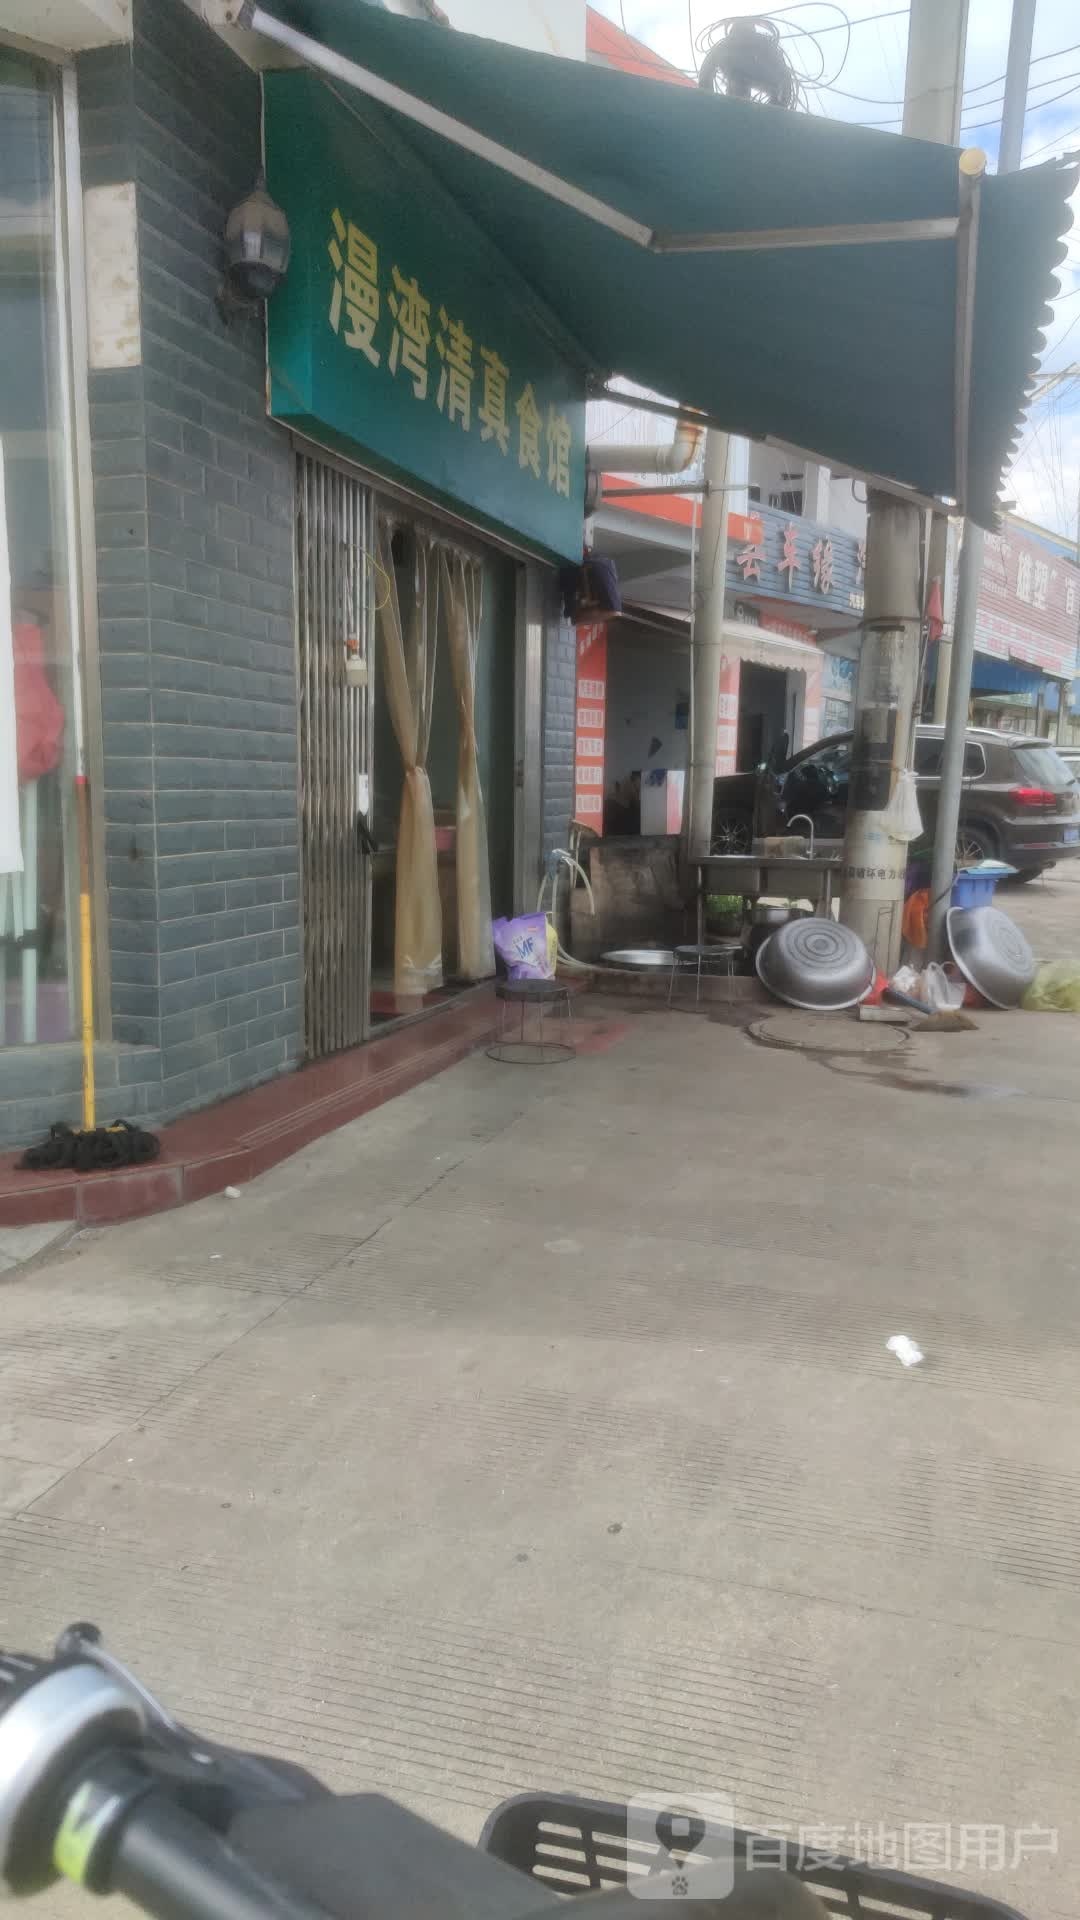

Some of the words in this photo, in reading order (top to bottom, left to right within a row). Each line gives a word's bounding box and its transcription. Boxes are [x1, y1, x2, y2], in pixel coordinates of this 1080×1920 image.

[327, 207, 572, 498] 漫湾清真食馆
